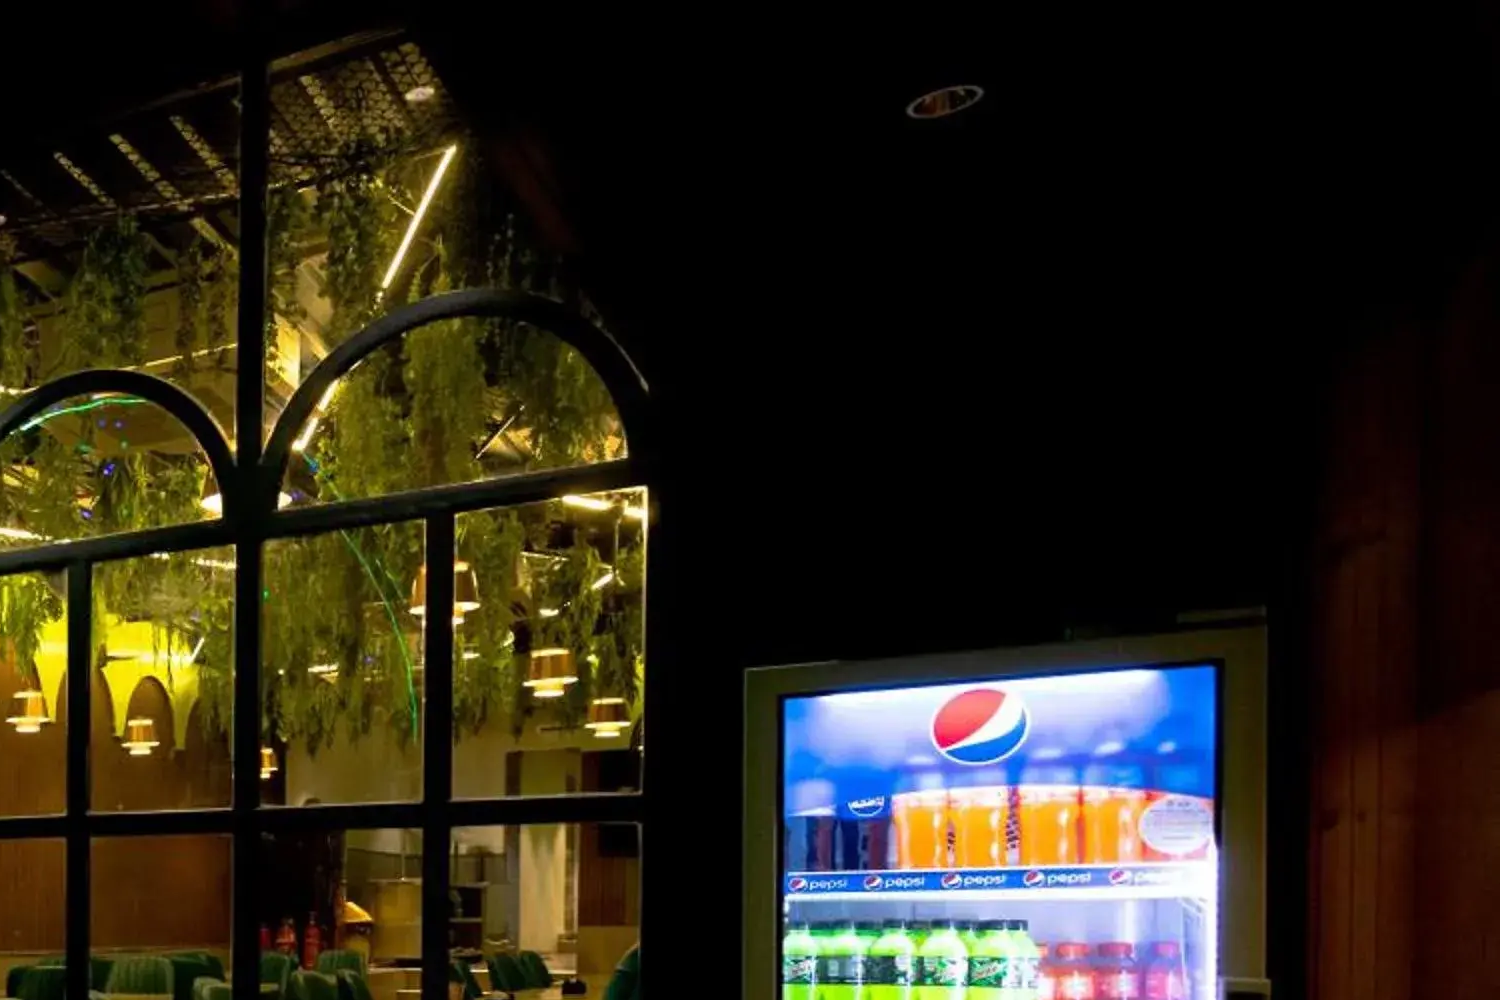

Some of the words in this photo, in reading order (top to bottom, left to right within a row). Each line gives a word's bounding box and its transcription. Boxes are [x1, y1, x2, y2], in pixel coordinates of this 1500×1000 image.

[885, 877, 926, 889] pepsi
[963, 874, 1007, 887] pepsi
[1047, 871, 1092, 885] pepsi
[809, 879, 848, 891] pepsi
